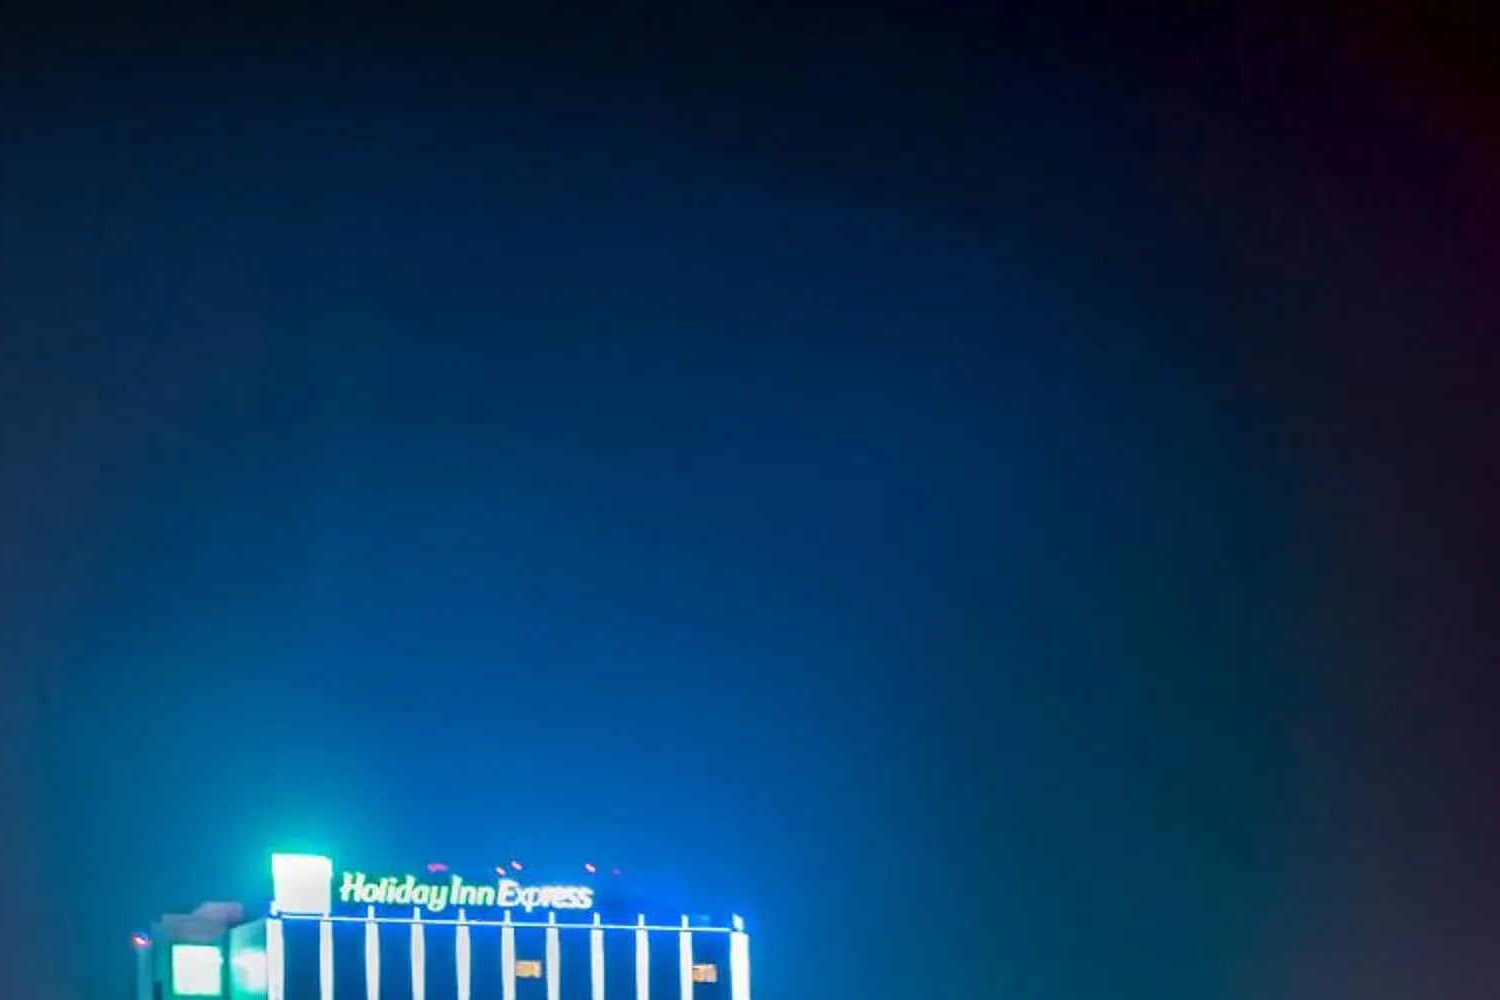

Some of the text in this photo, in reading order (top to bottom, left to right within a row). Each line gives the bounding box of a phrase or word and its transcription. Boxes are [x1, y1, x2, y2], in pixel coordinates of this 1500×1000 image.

[340, 872, 594, 912] Holiday Inn Express
